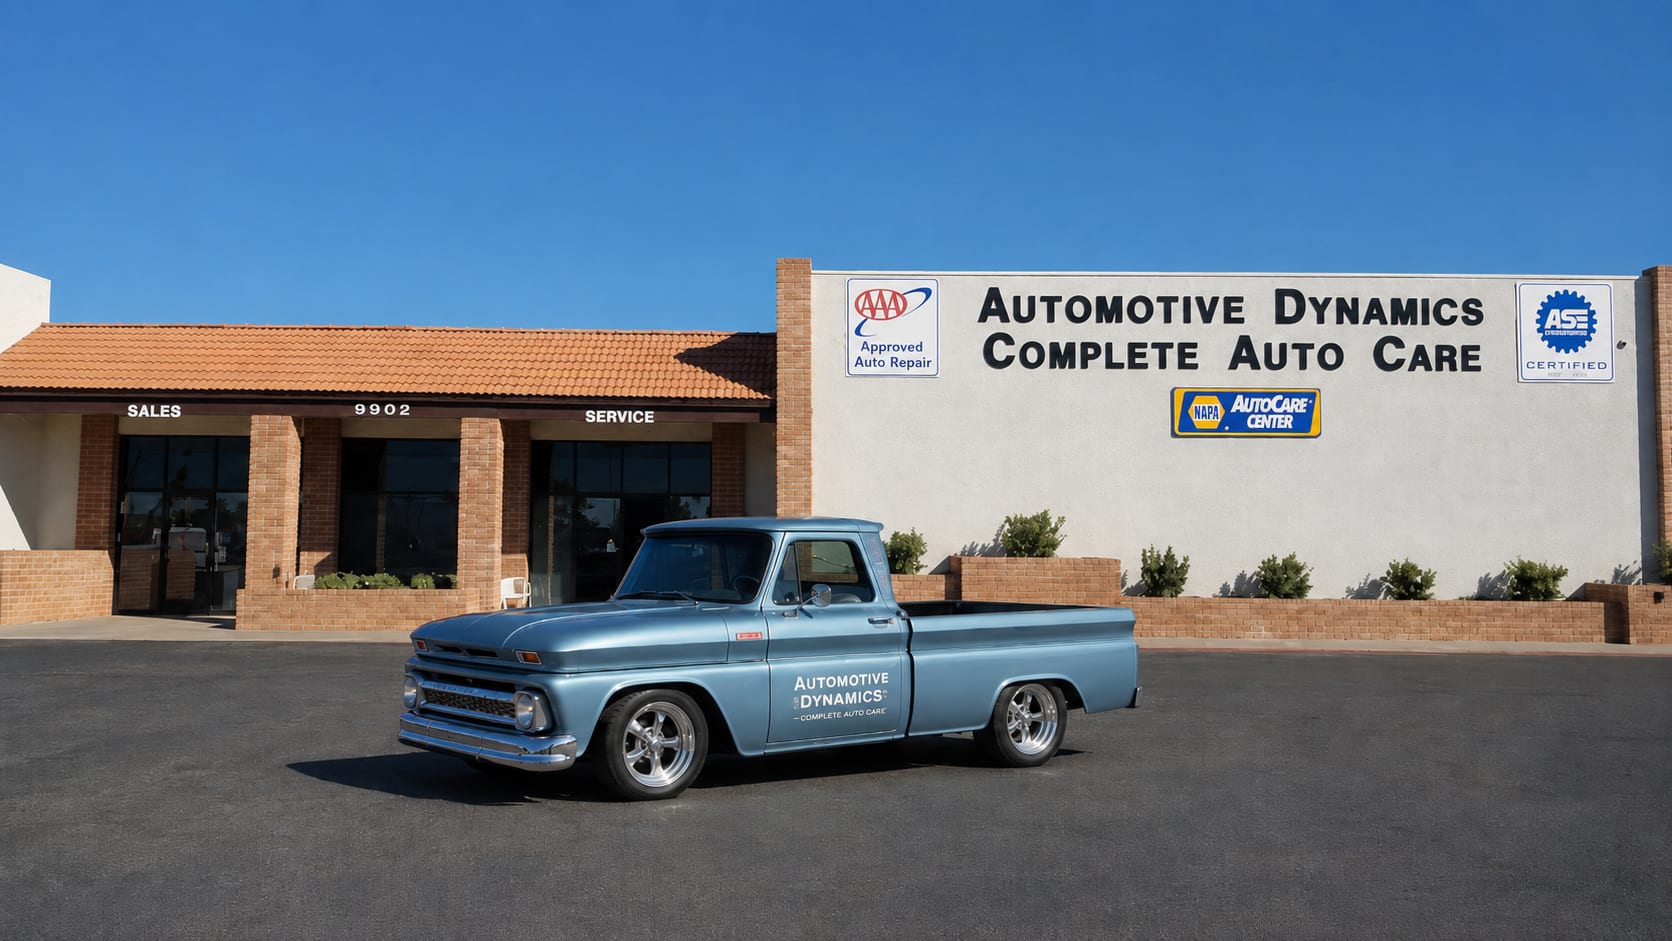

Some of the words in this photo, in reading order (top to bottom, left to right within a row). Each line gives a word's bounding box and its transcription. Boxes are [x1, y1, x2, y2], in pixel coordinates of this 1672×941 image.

[860, 289, 902, 320] AAA
[977, 287, 1245, 324] AUTOMOTIVE
[1275, 288, 1484, 326] DYNAMICS
[1544, 308, 1588, 329] ASE
[860, 341, 923, 355] Approved
[982, 332, 1199, 370] COMPLETE
[1229, 335, 1345, 371] AUTO
[1373, 335, 1482, 372] CARE
[854, 356, 885, 368] Auto
[890, 356, 932, 370] Repair
[1526, 361, 1608, 370] CERTIFIED
[127, 404, 182, 418] SALES
[354, 403, 411, 416] 9902
[585, 410, 655, 424] SERVICE
[1193, 405, 1219, 420] NAPA
[1246, 414, 1293, 429] CENTER
[793, 672, 889, 691] AUTOMOTIVE
[801, 690, 882, 708] DYNAMICS
[844, 709, 864, 717] AUTO
[866, 707, 887, 716] CARE
